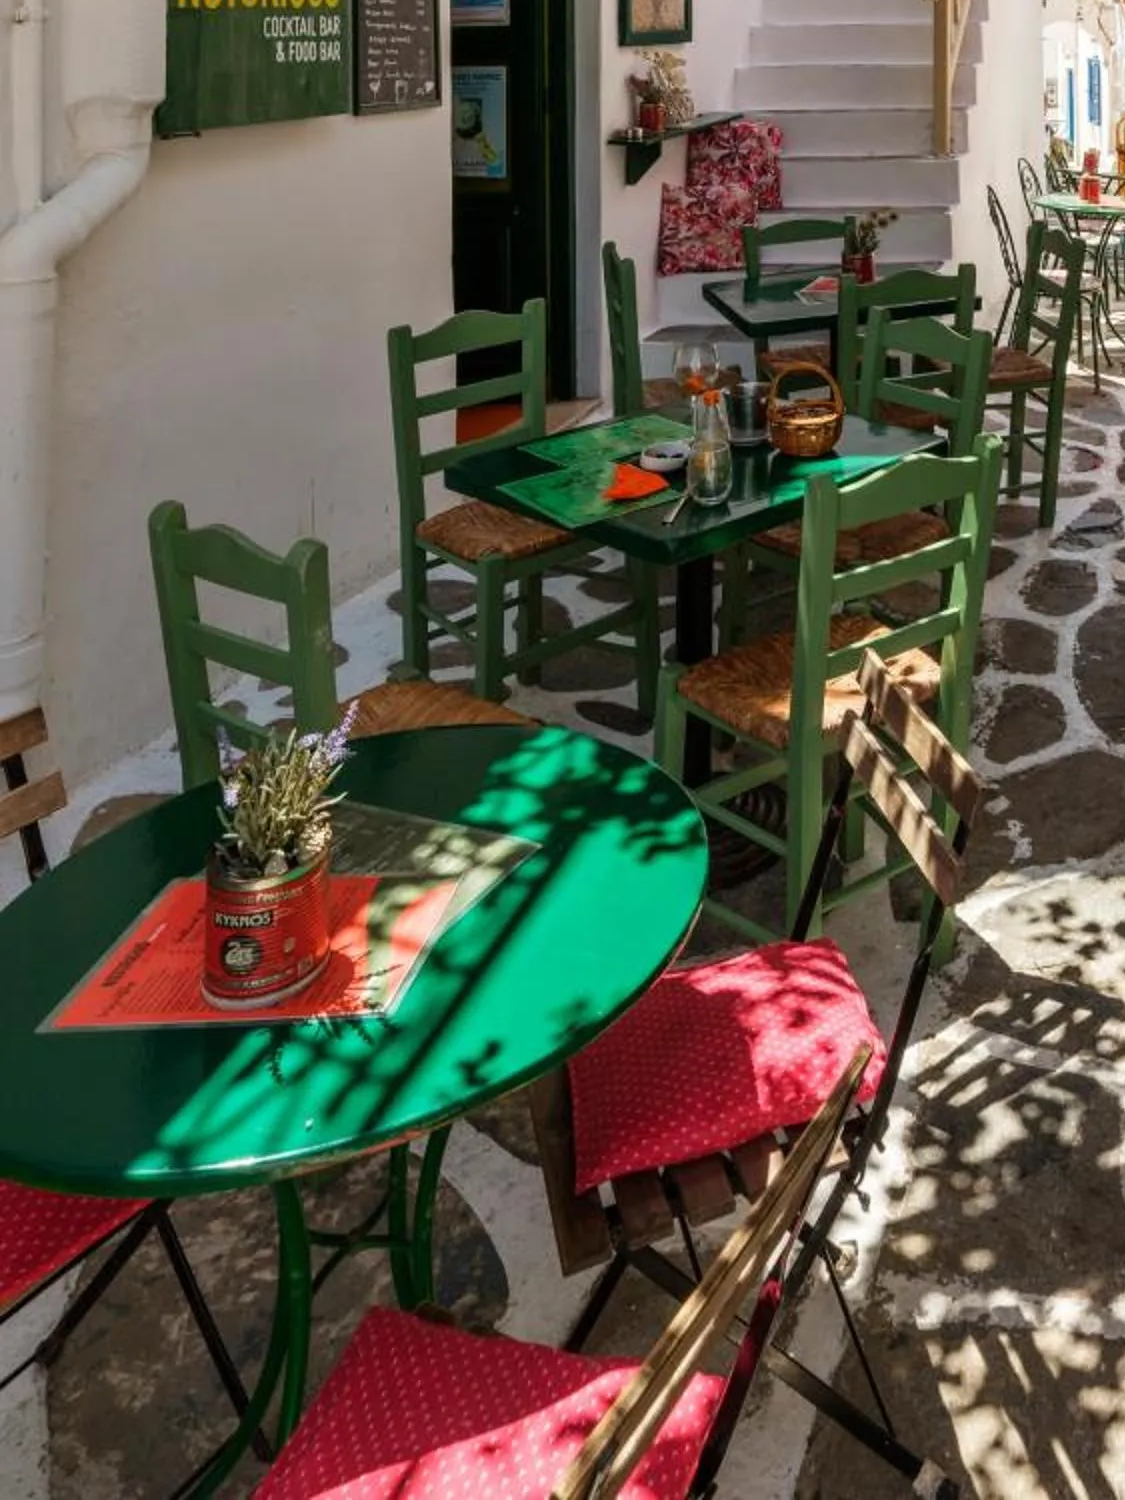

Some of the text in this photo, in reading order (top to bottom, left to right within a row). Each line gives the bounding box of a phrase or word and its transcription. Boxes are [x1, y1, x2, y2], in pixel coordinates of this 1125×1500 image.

[263, 16, 316, 38] COCKTAIL
[319, 16, 341, 37] BAR
[275, 41, 341, 63] & FOOD BAR
[214, 911, 272, 928] KYKNOS
